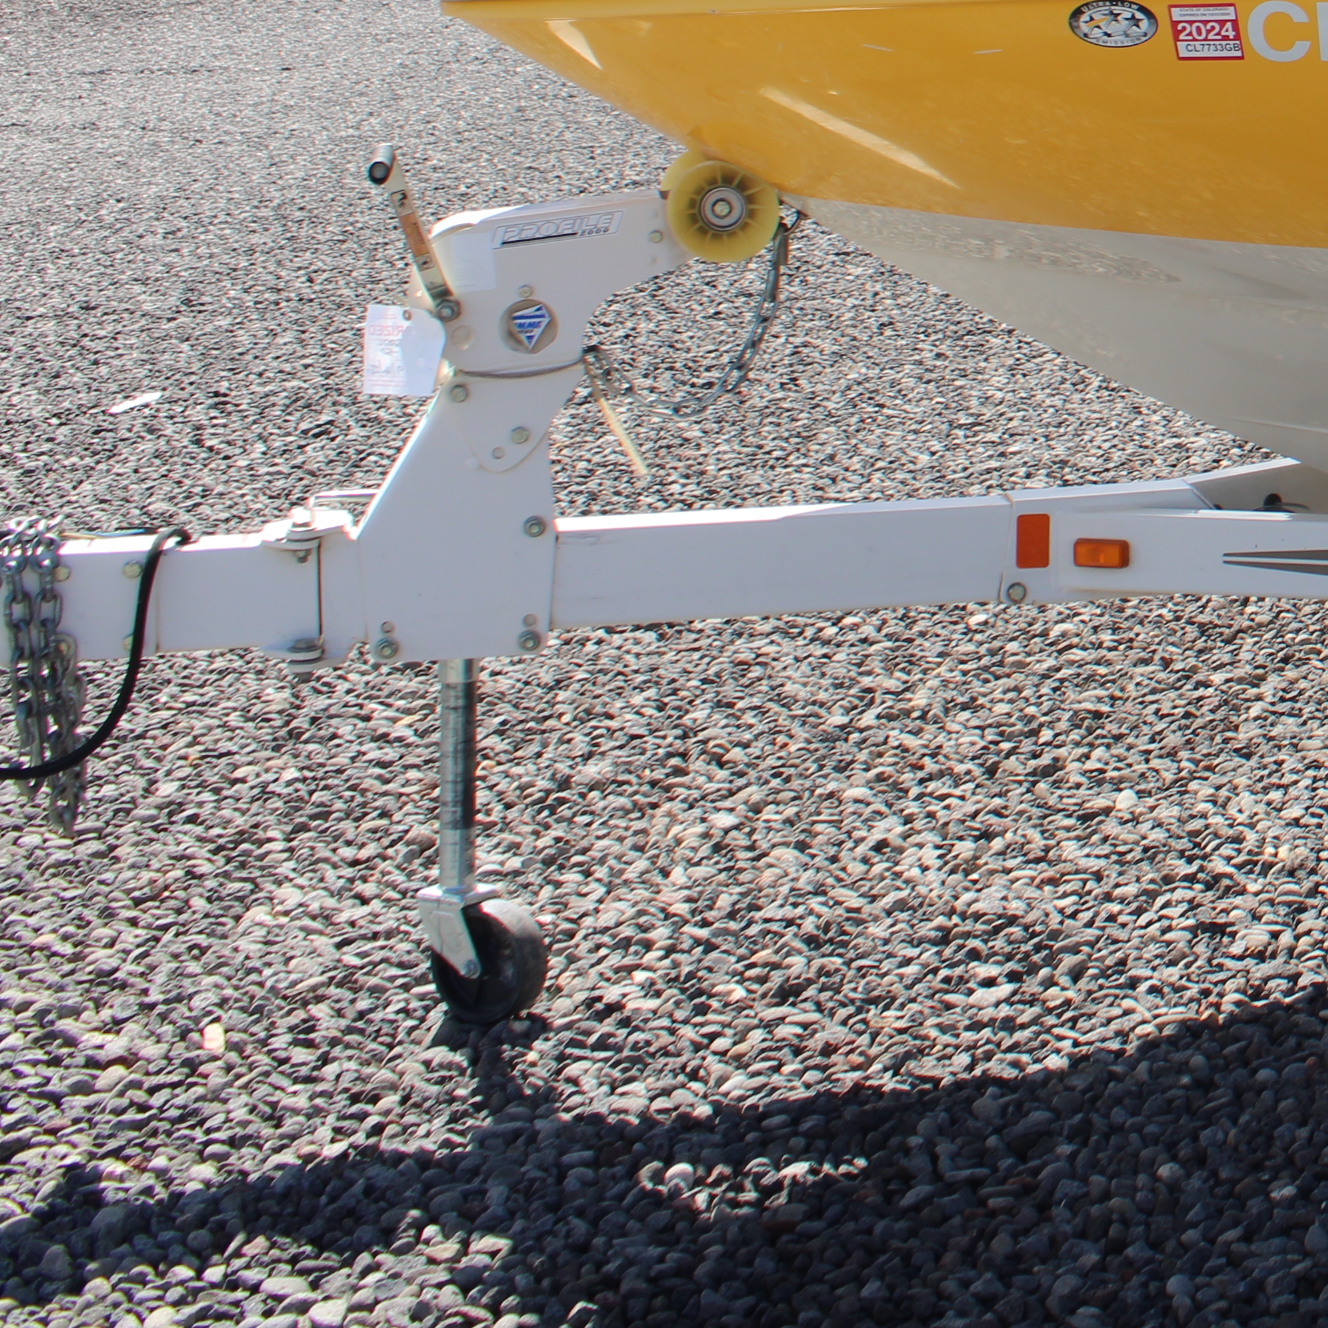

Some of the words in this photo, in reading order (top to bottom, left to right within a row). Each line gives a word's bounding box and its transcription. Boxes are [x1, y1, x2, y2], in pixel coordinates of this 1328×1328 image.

[1177, 22, 1236, 40] 2024
[1185, 42, 1241, 52] CL7733GB
[501, 213, 613, 243] PROFILE
